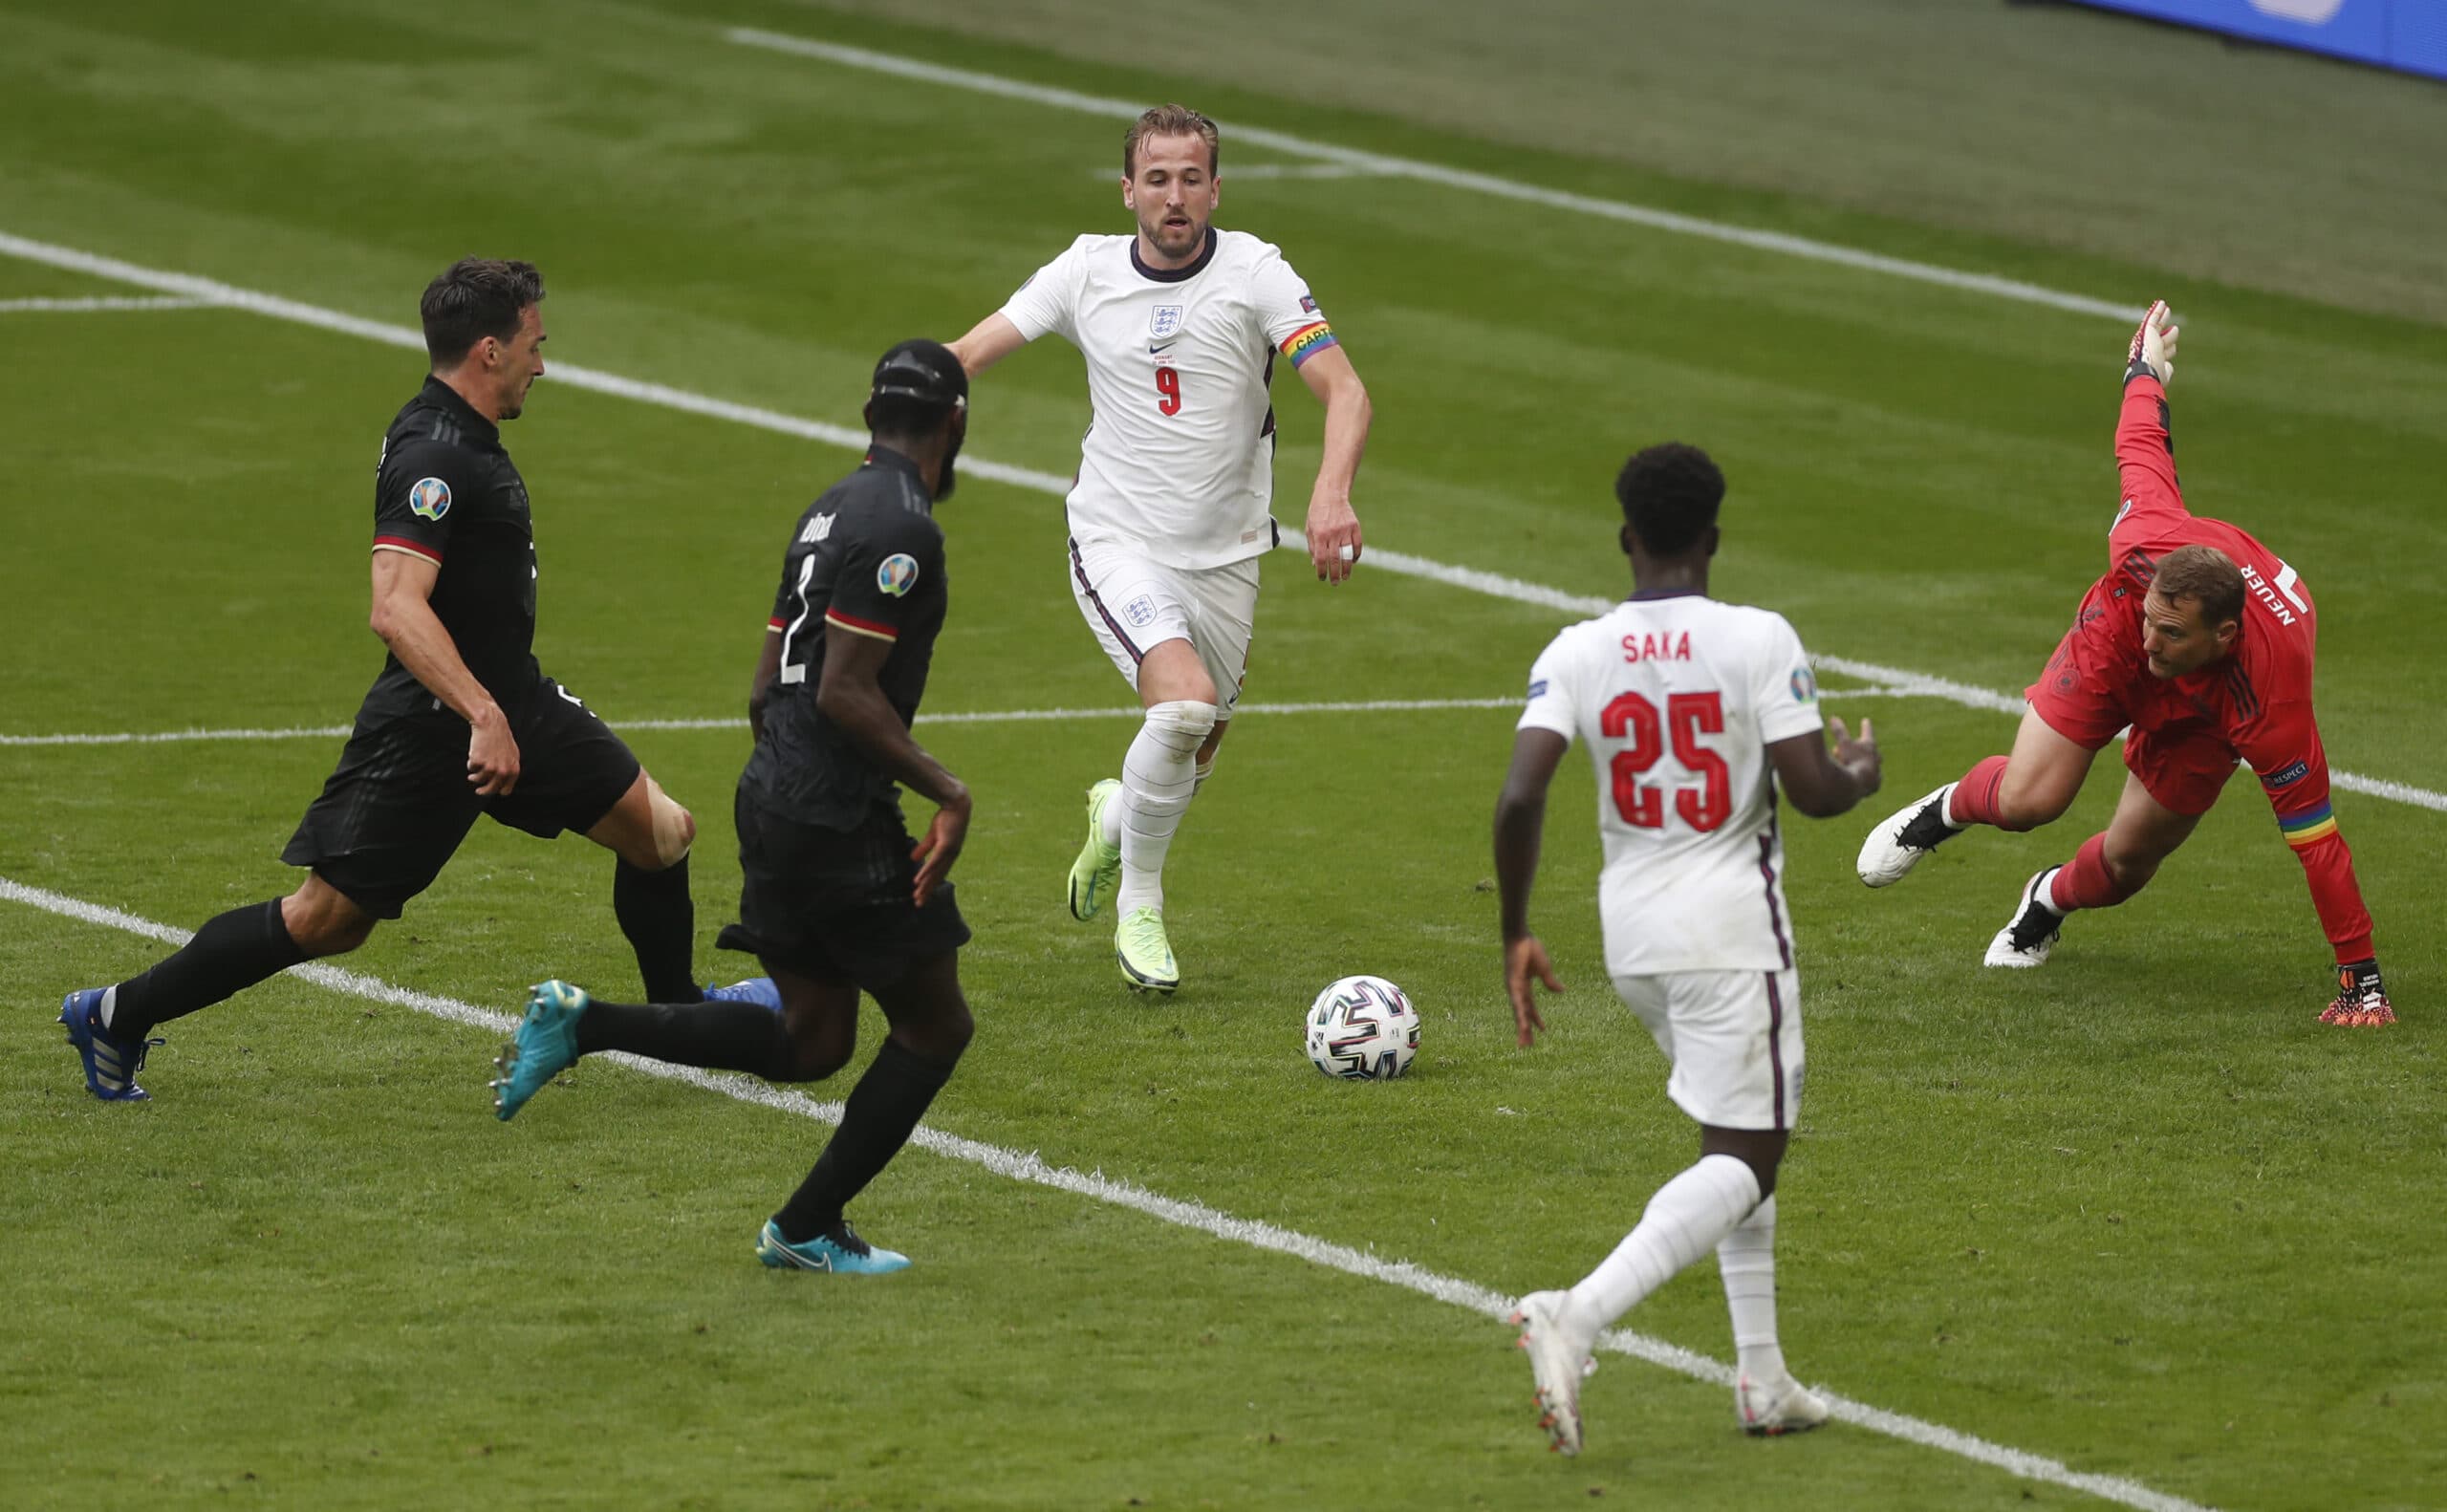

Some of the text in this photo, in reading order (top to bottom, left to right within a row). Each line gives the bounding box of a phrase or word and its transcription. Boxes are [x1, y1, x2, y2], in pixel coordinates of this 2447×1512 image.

[1296, 328, 1334, 351] CAPT
[1155, 366, 1181, 417] 9
[781, 553, 815, 684] 2
[2240, 564, 2296, 626] NEUER
[1622, 631, 1691, 662] SAKA
[1600, 691, 1732, 833] 25
